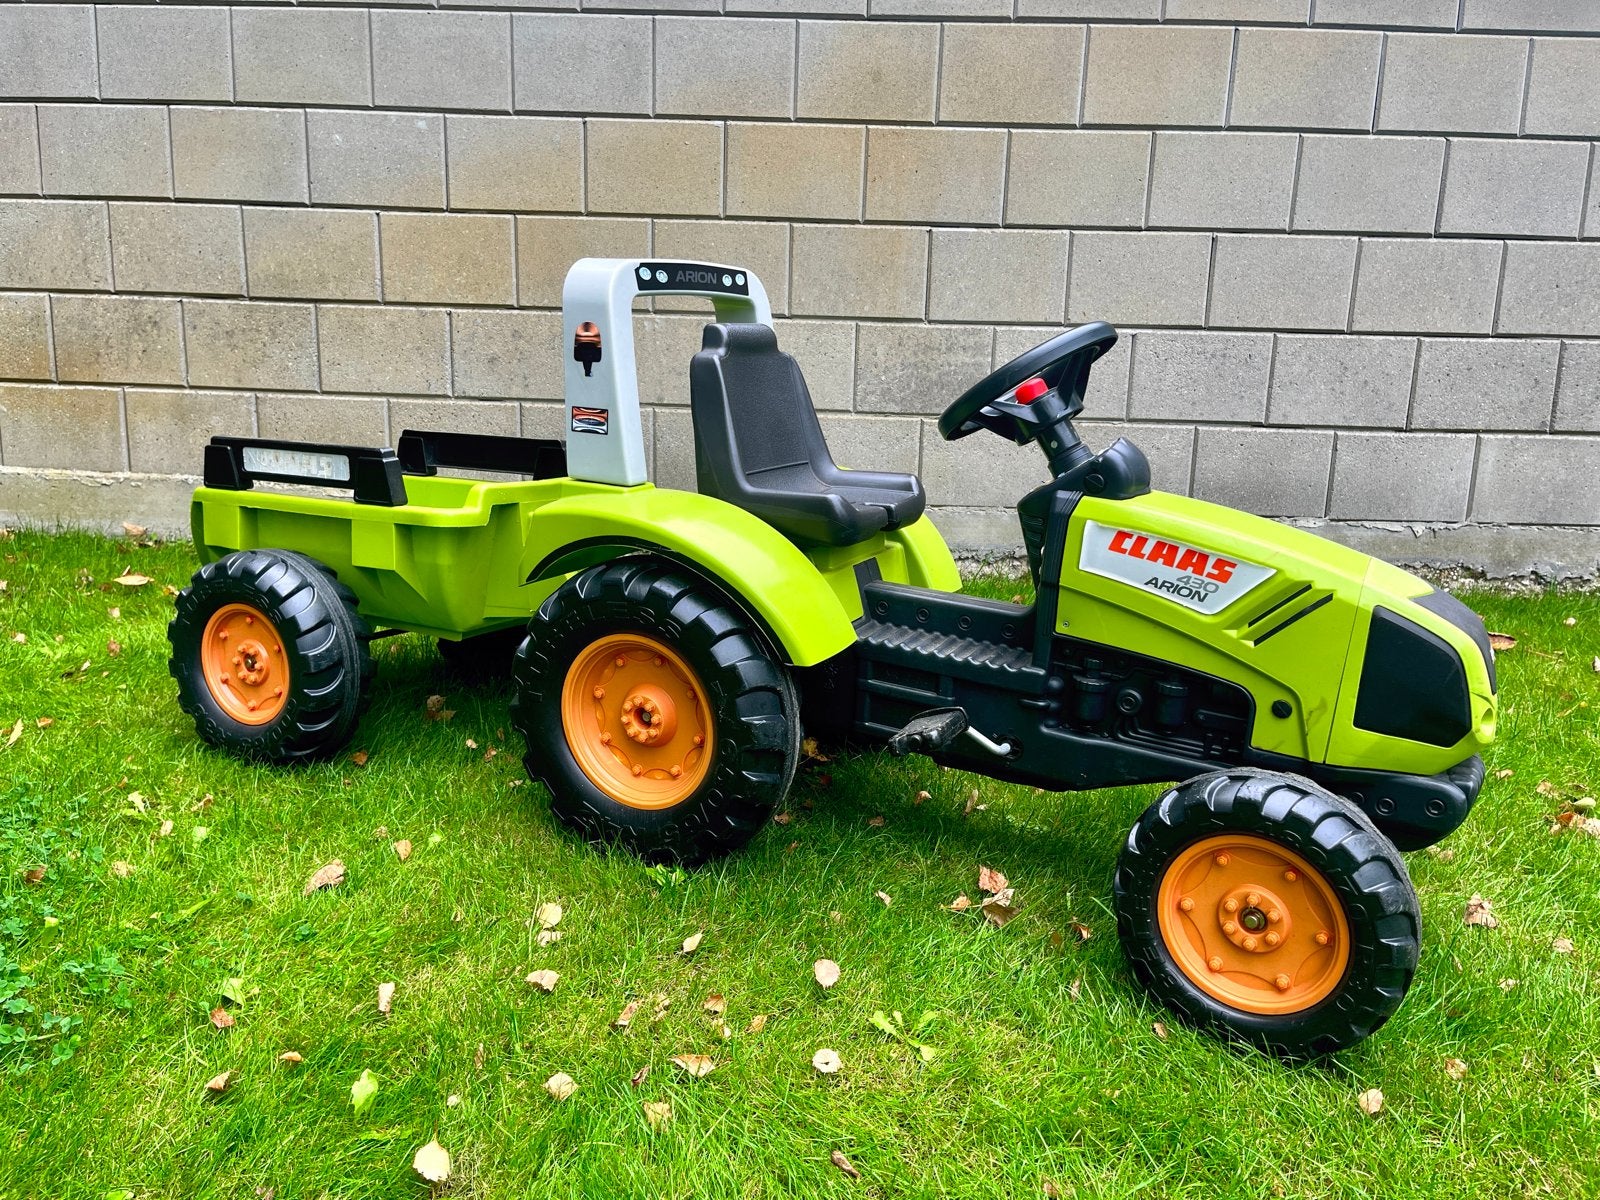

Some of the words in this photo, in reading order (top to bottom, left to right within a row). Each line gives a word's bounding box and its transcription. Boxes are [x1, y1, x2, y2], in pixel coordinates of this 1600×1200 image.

[676, 270, 718, 284] ARION
[1108, 530, 1238, 584] CLAAS
[1144, 577, 1209, 603] ARION
[1176, 575, 1220, 595] 430
